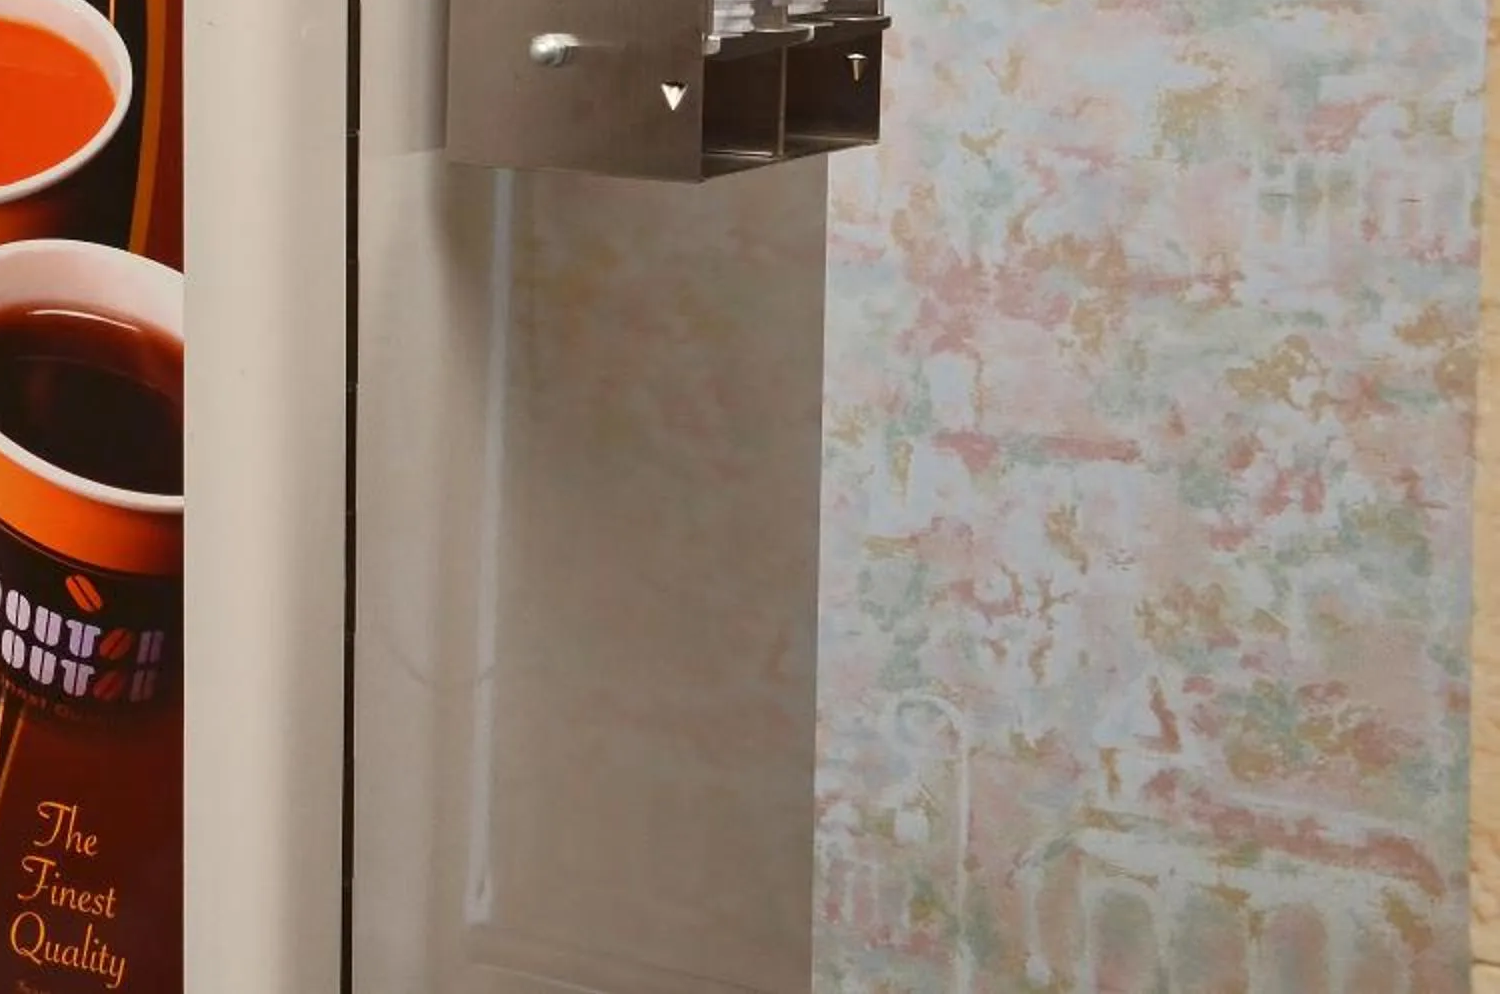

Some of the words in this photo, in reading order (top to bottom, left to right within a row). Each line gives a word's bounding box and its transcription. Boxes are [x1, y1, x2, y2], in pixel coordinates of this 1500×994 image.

[32, 801, 99, 856] The
[16, 855, 117, 919] Finest
[10, 910, 127, 990] Quality
